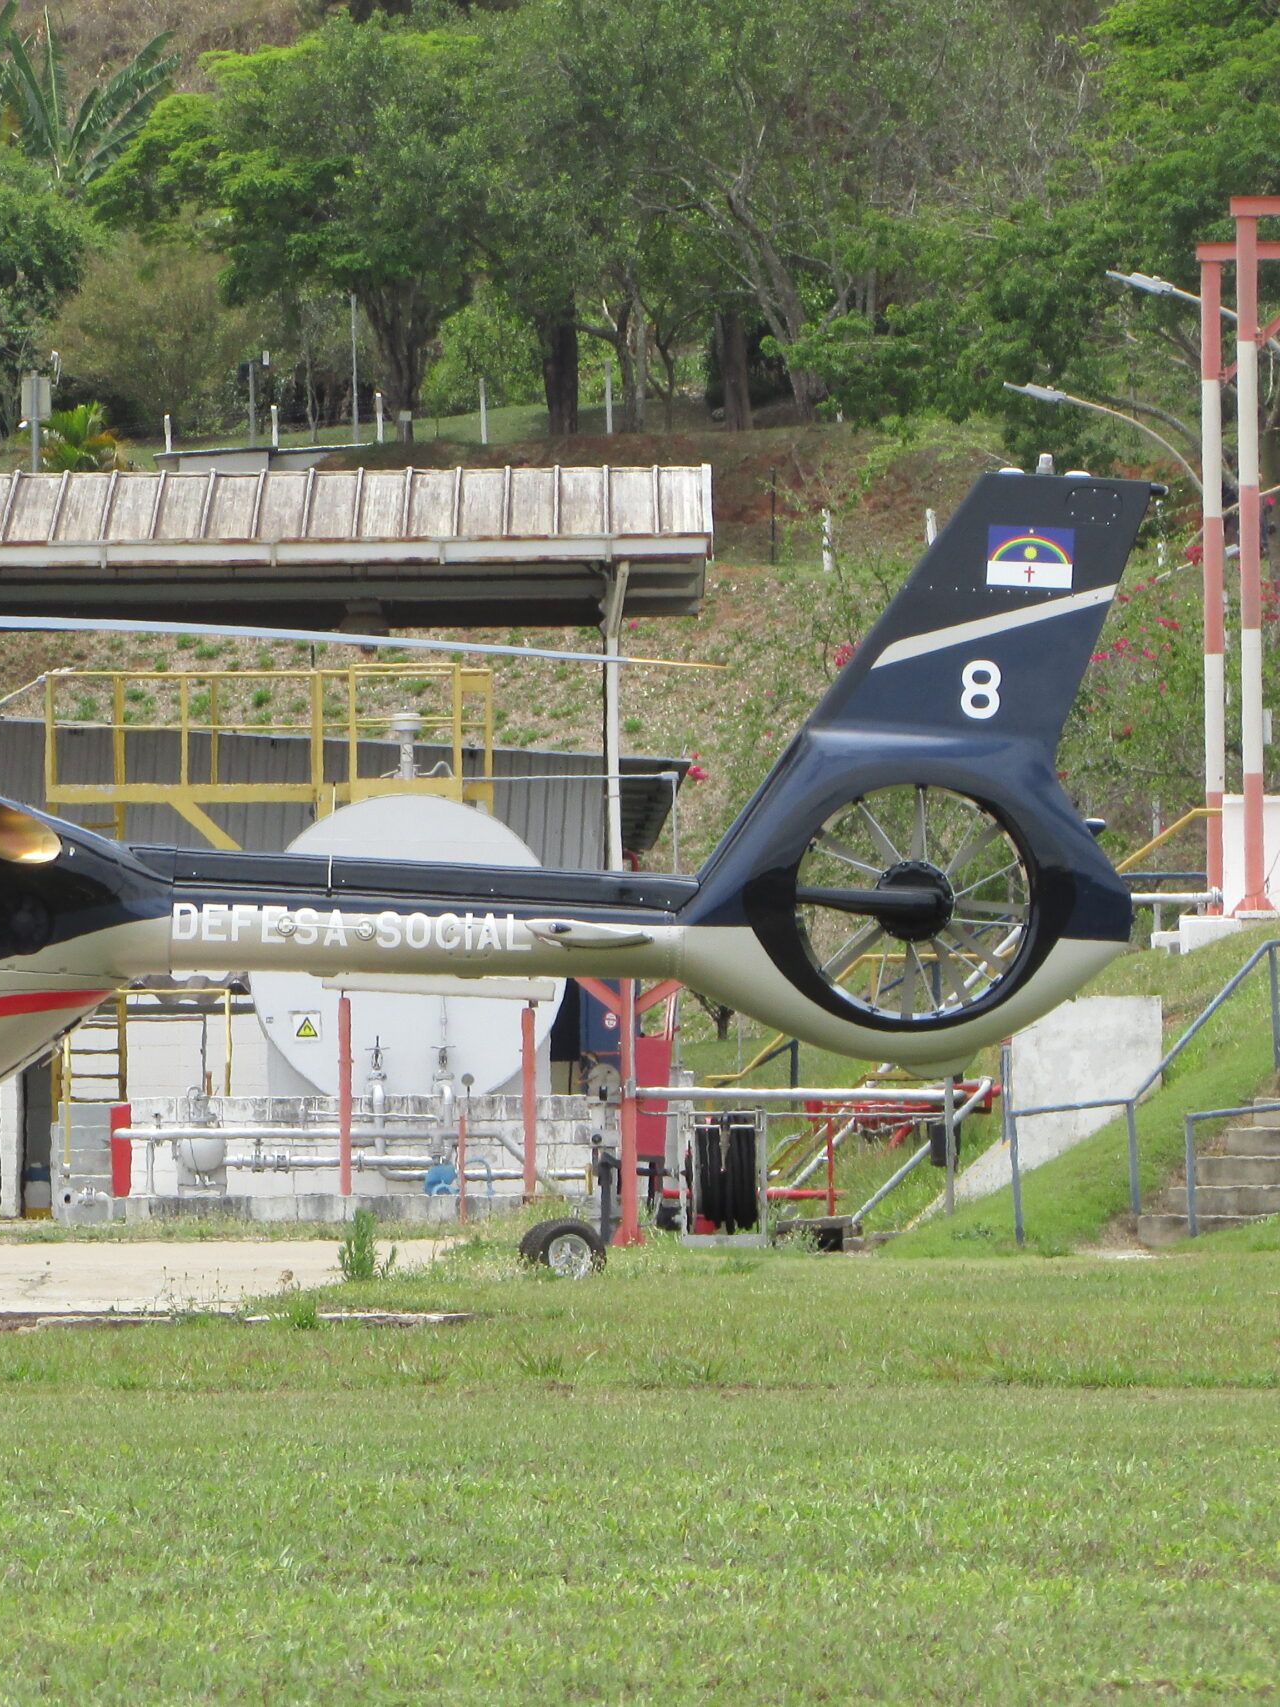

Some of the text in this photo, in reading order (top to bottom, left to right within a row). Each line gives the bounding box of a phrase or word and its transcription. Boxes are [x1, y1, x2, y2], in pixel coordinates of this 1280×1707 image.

[960, 659, 1001, 720] 8
[172, 902, 532, 951] DEFESA SOCIAL
